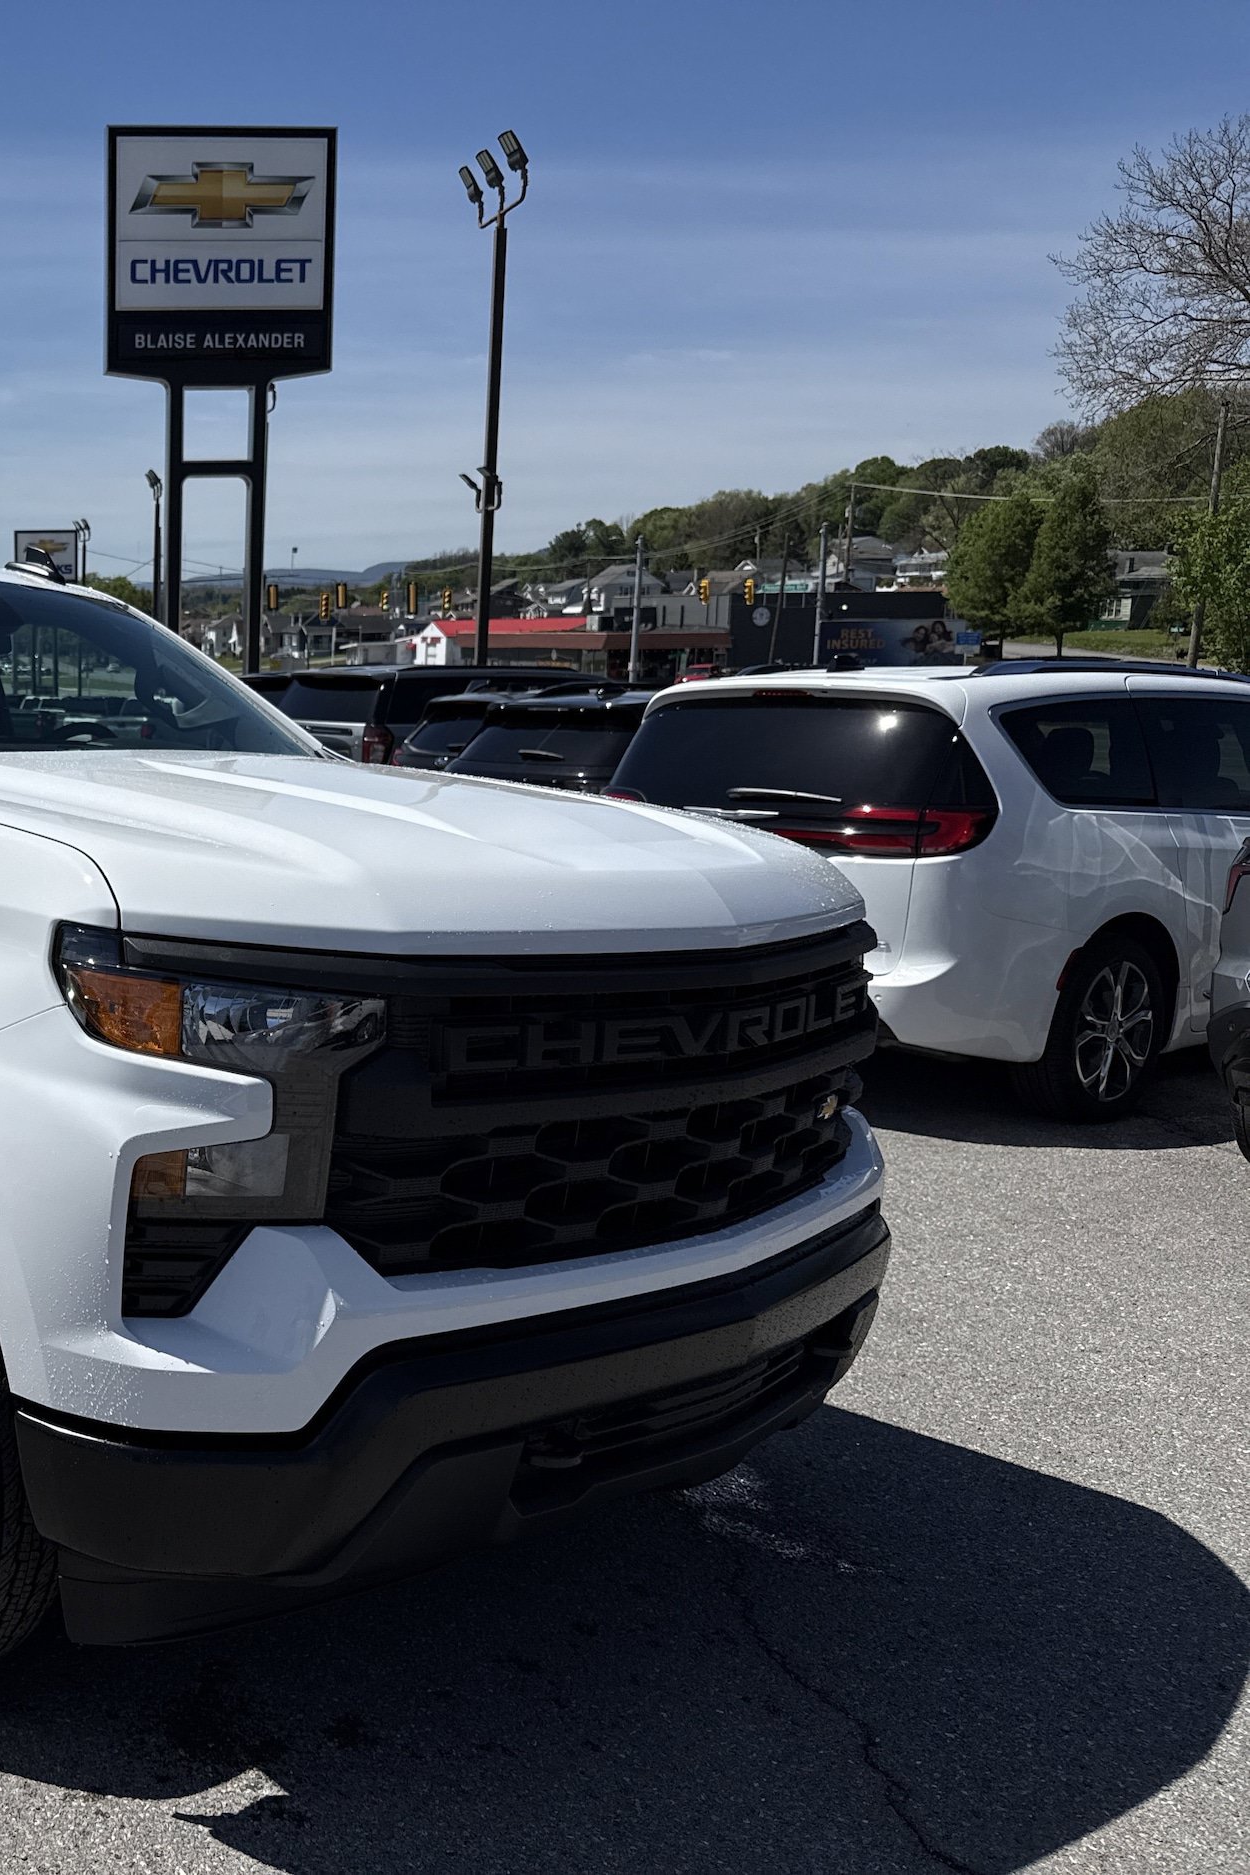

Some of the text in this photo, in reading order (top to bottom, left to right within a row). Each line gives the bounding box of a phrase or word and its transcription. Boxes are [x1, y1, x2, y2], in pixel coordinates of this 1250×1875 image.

[130, 259, 312, 284] CHEVROLET
[135, 333, 305, 349] BLAISE ALEXANDER
[840, 628, 874, 639] REST
[826, 639, 886, 650] INSURED
